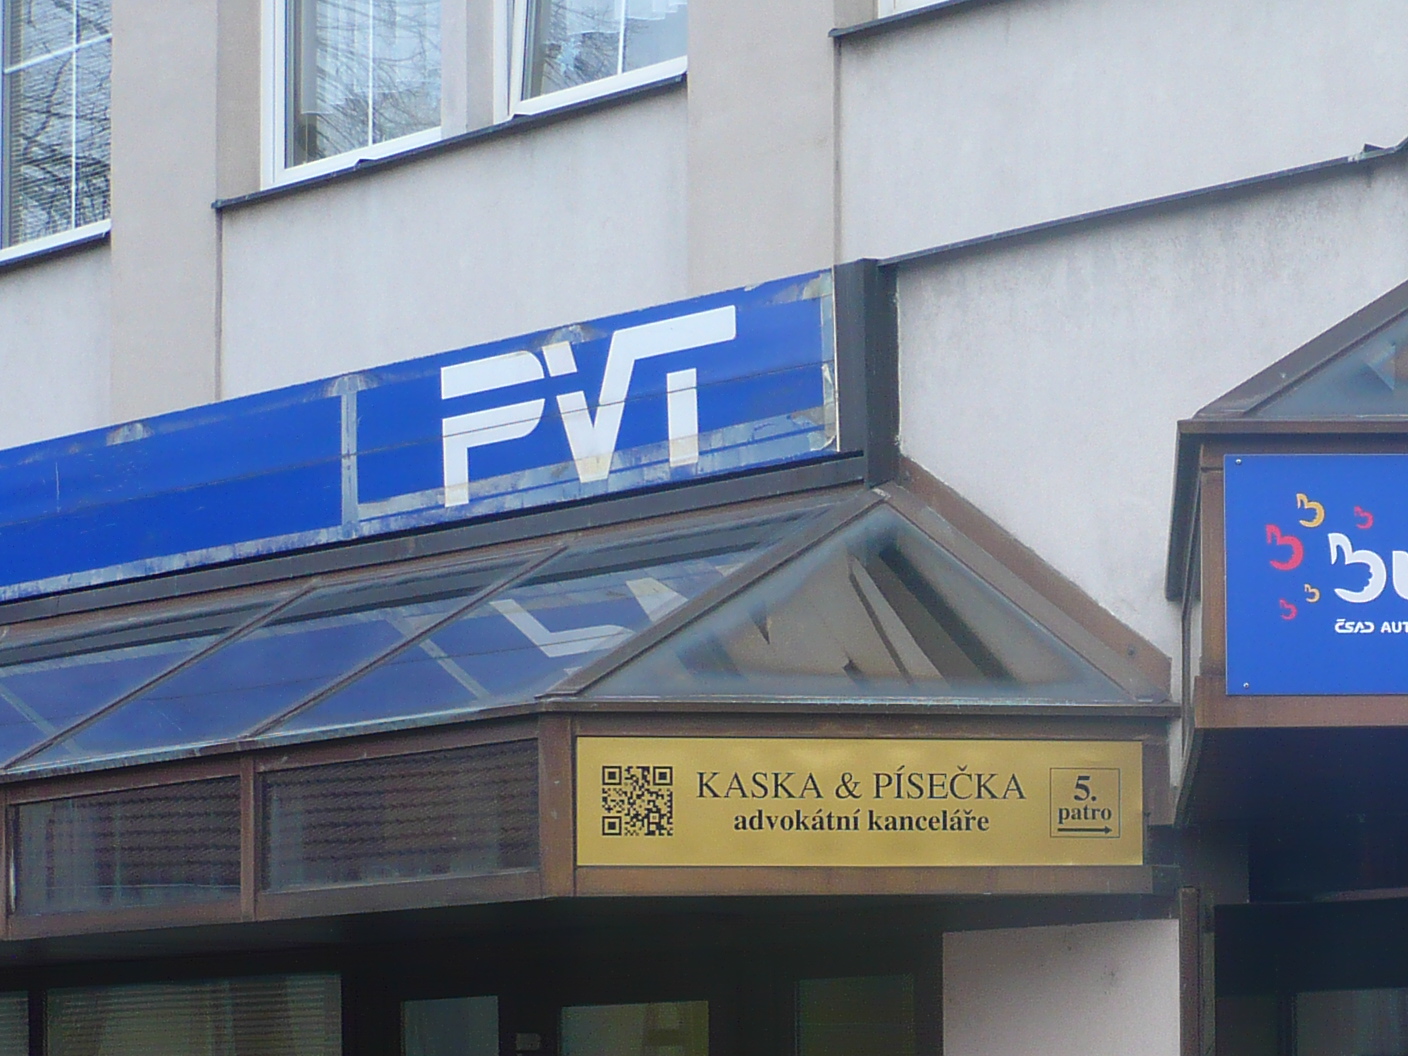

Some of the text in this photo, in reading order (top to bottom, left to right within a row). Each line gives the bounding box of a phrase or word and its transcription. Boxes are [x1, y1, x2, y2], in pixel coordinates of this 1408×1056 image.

[440, 305, 737, 508] PVT
[695, 764, 1028, 801] KASKA & PÍSEČKA
[1072, 775, 1098, 802] 5.
[732, 808, 991, 833] advokátní kanceláře
[1057, 804, 1113, 824] patro
